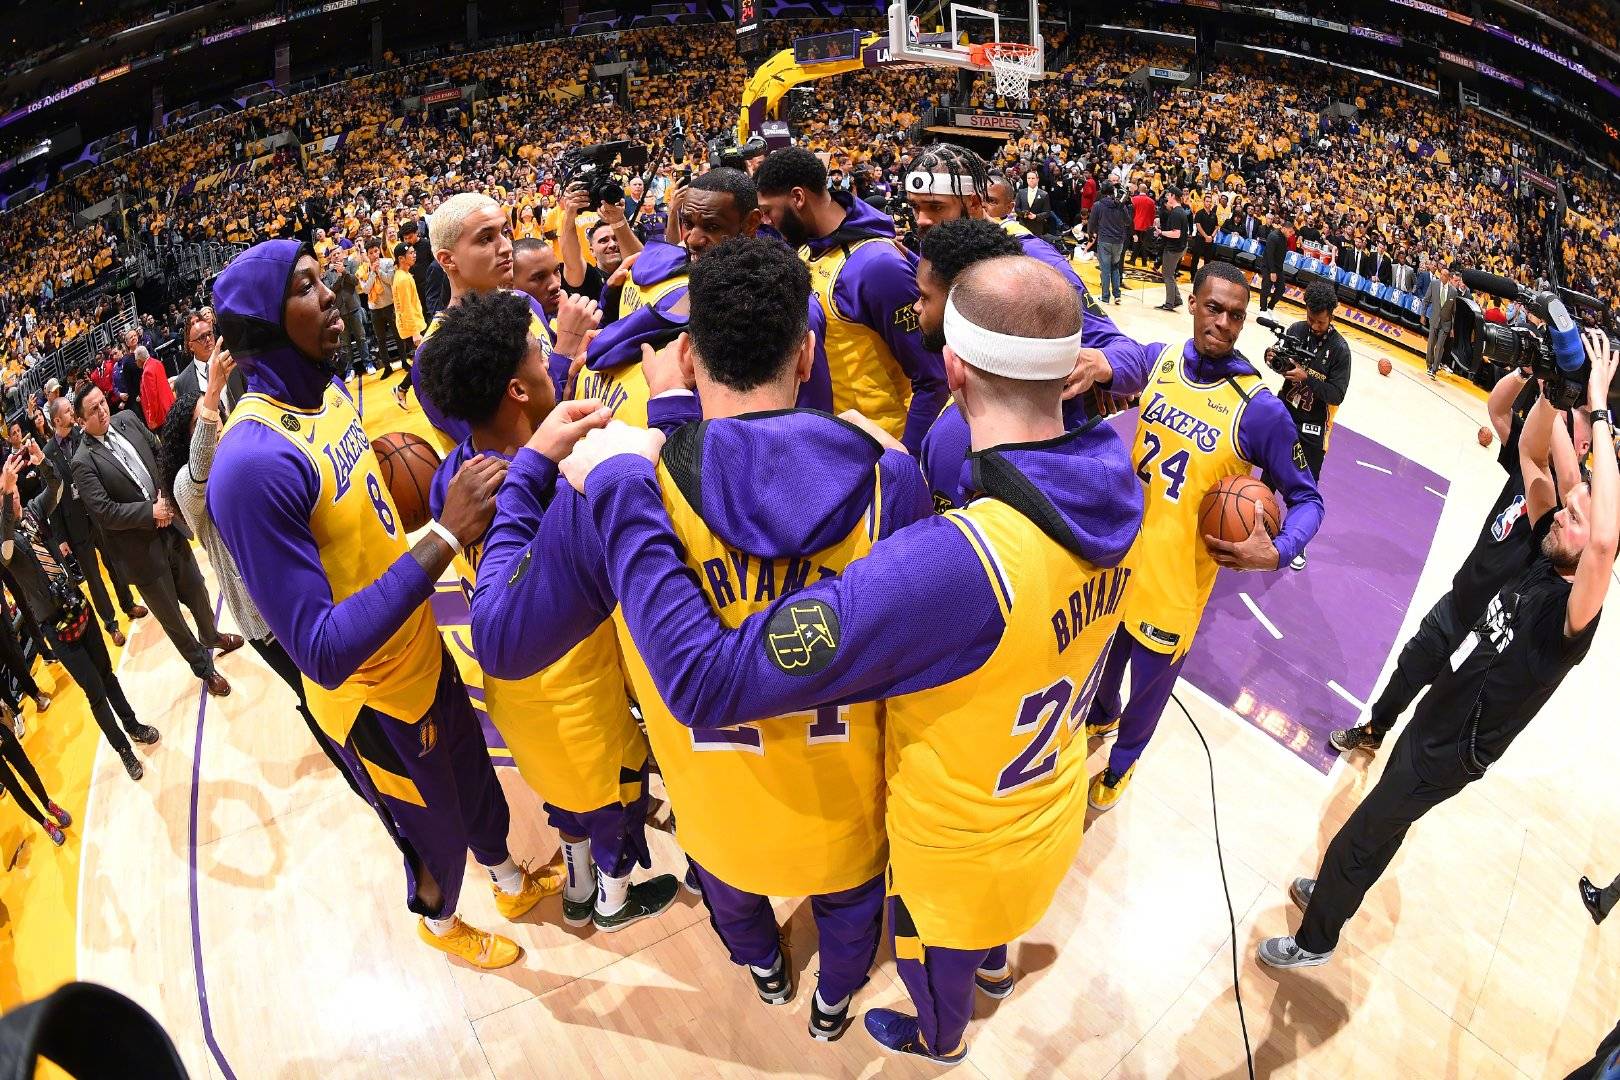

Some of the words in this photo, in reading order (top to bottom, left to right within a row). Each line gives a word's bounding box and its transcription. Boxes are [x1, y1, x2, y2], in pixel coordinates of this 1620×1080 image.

[1440, 51, 1475, 69] TOSHIBA
[1513, 35, 1530, 49] LOS
[1531, 44, 1568, 67] ANGELES
[1568, 60, 1598, 83] LAKERS
[28, 100, 43, 114] LOS
[43, 83, 79, 108] ANGELES
[970, 116, 1021, 129] STAPLES
[1141, 392, 1222, 453] LAKERS
[1207, 397, 1230, 416] wish
[323, 418, 371, 504] LAKERS
[1136, 430, 1191, 505] 24
[365, 469, 400, 541] 8
[1050, 566, 1132, 656] BRYANT
[993, 625, 1119, 798] 24
